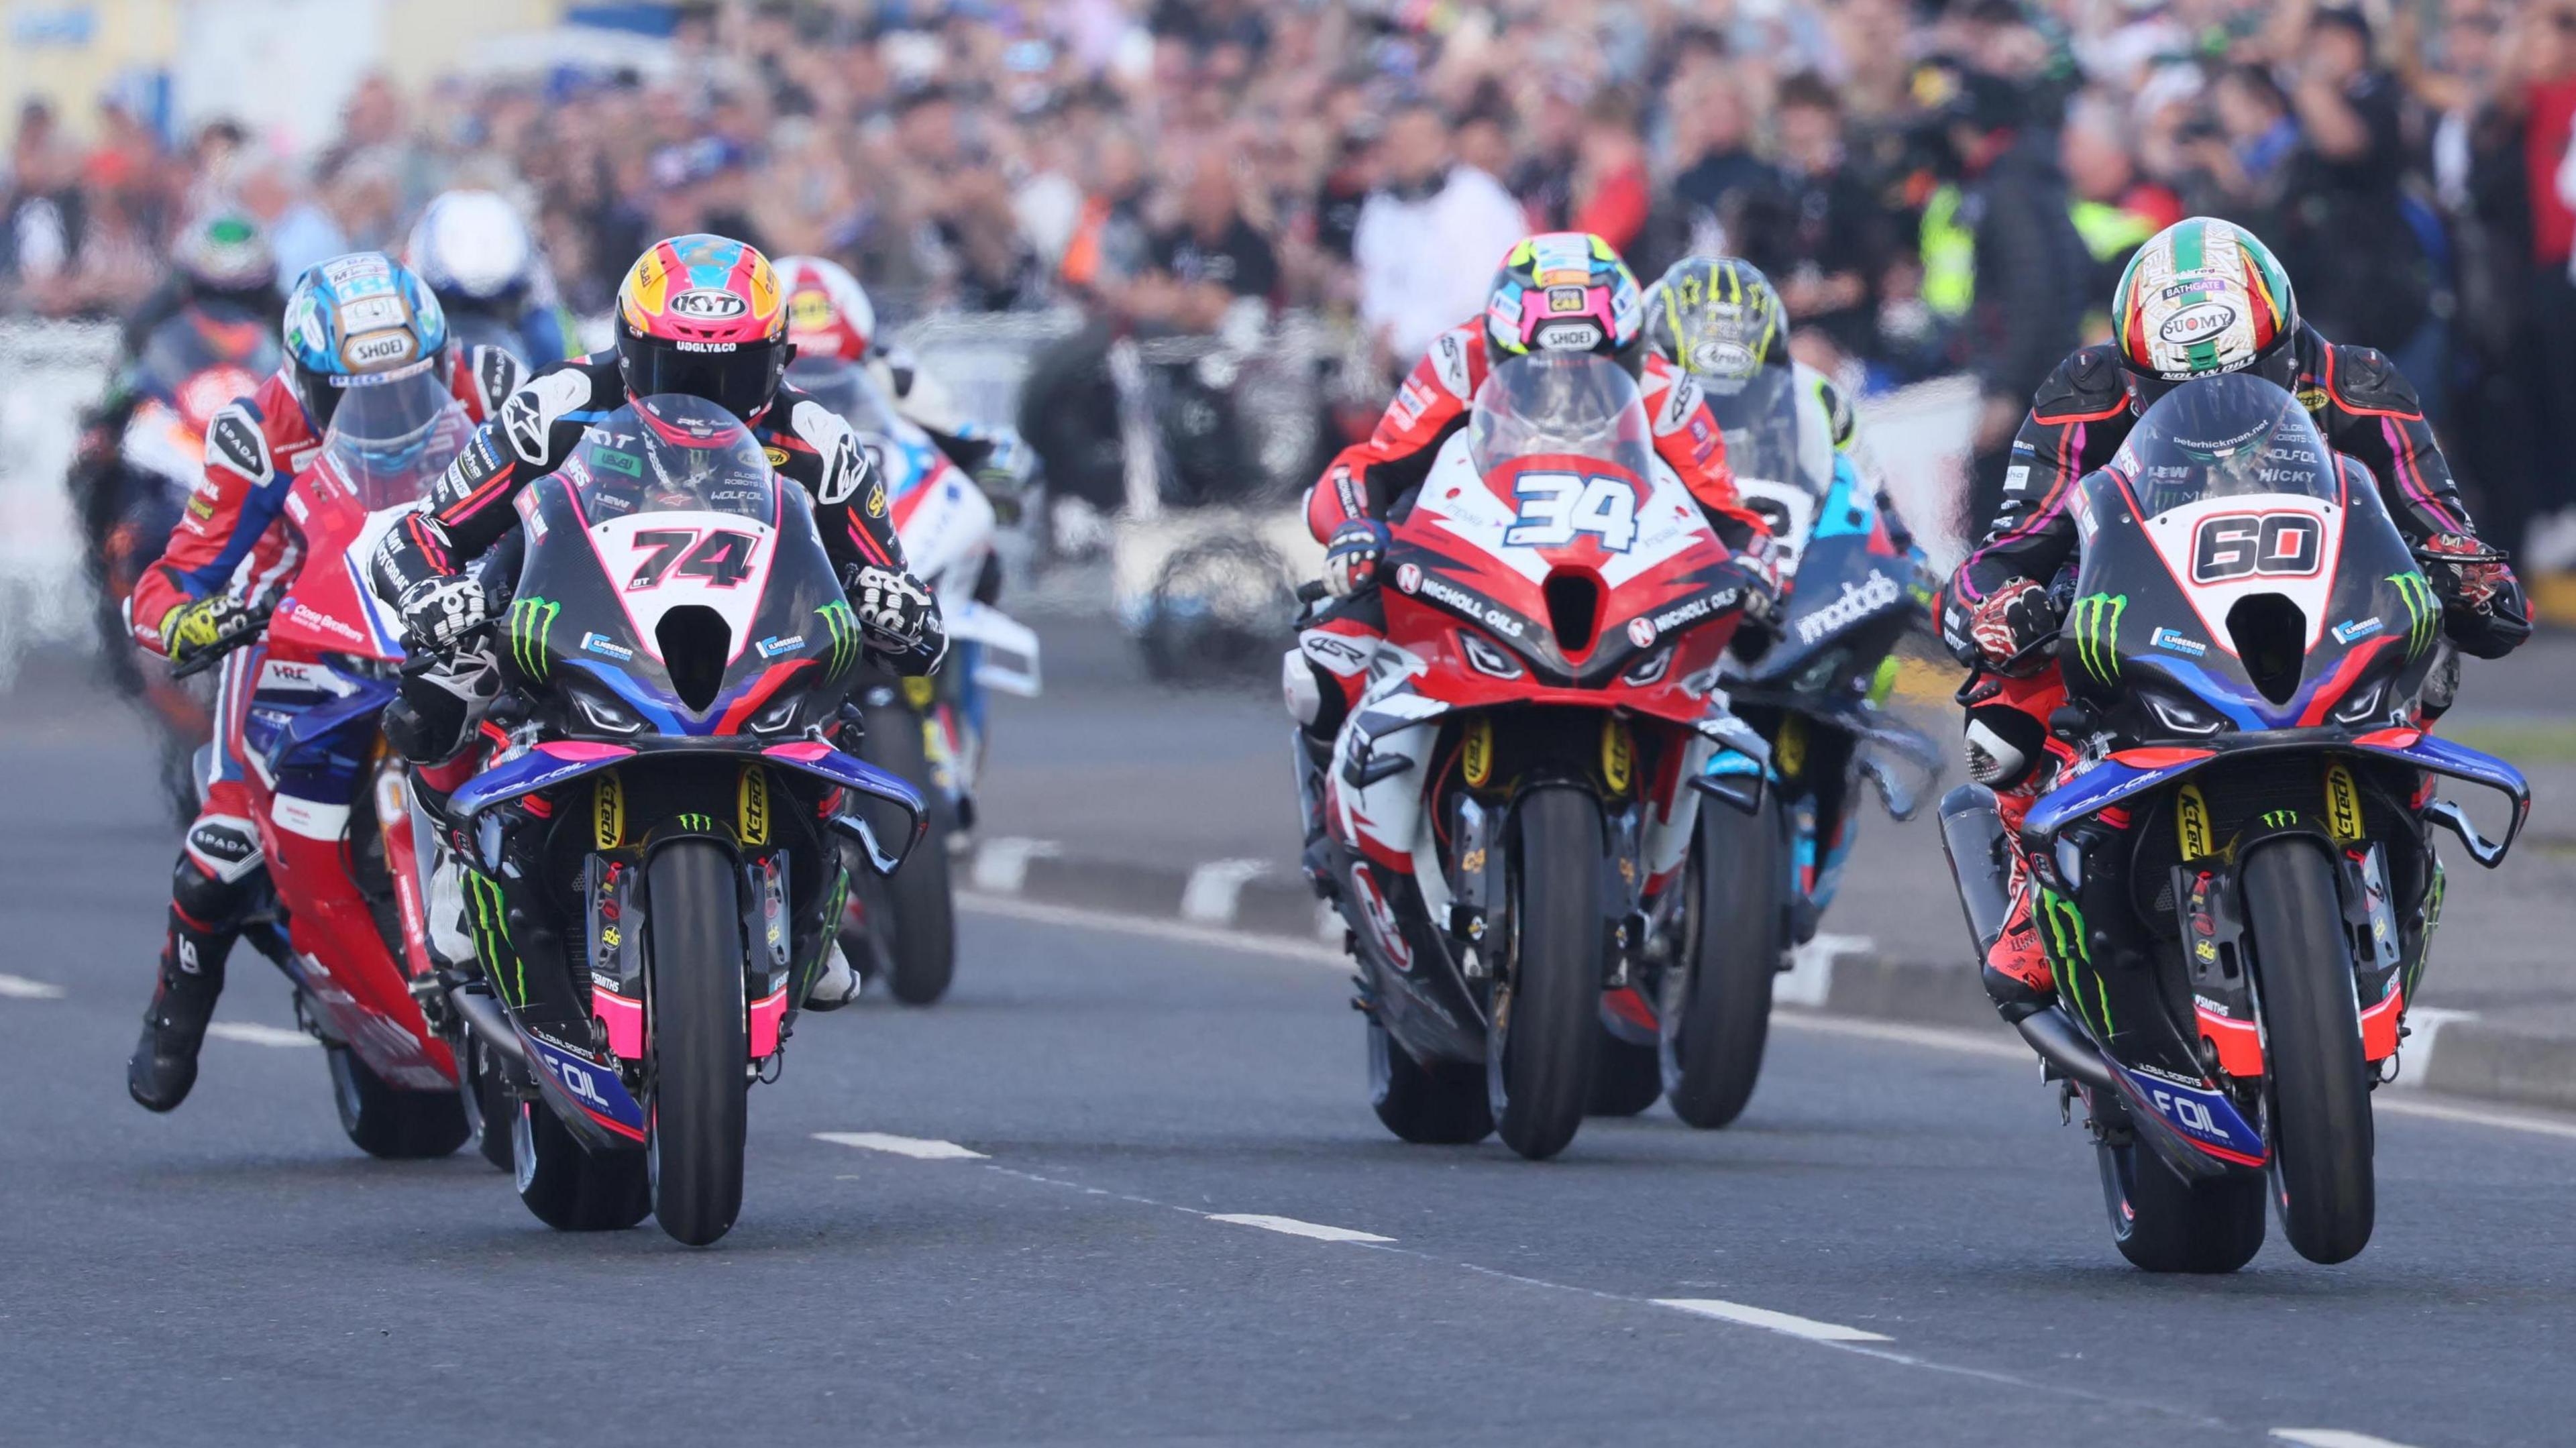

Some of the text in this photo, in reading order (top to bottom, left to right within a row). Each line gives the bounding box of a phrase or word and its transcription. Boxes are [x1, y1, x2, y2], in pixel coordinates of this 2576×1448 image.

[2166, 281, 2221, 297] BATHGATE
[677, 295, 738, 313] KYT
[2163, 313, 2230, 335] SUOMY
[1551, 331, 1591, 345] SHOEI
[358, 339, 403, 360] SHOEI
[2161, 367, 2219, 380] NOLAN
[219, 422, 258, 468] SPADA
[2259, 468, 2316, 483] HICKY
[1503, 471, 1638, 555] 34
[2188, 509, 2327, 588] 60
[624, 528, 763, 592] 74
[1421, 579, 1482, 618] NICHOLL
[1485, 611, 1524, 637] OILS
[1654, 599, 1710, 632] NICHOLL
[1711, 588, 1737, 609] OILS
[294, 604, 322, 624] Close
[321, 614, 366, 643] Brothers
[2163, 634, 2206, 651] ILMBERGER
[272, 663, 311, 681] HRC
[600, 773, 617, 846] K-tech
[746, 769, 763, 845] K-tech
[2330, 770, 2355, 840] K-tech
[197, 831, 249, 853] SPADA
[594, 974, 619, 993] SMITHS
[2200, 997, 2229, 1017] SMITHS
[537, 1030, 594, 1060] GLOBAL ROBOTS
[2167, 1070, 2202, 1087] ROBOTS
